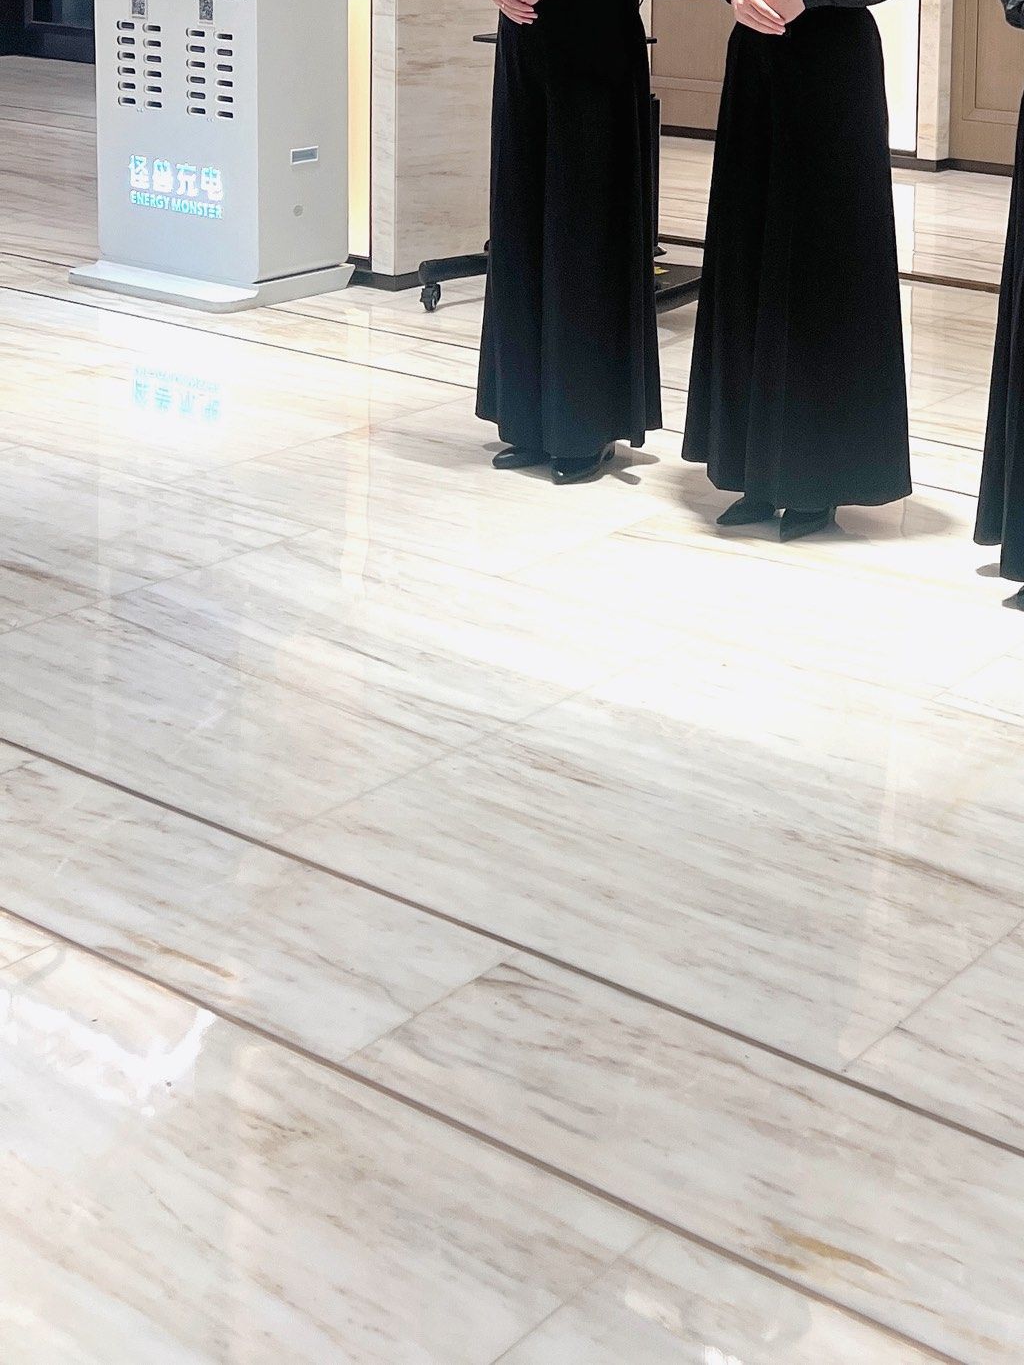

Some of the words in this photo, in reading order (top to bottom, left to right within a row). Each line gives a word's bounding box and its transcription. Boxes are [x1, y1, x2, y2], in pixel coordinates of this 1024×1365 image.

[128, 154, 224, 201] 怪兽充电
[130, 189, 170, 210] ENERGY
[171, 197, 224, 219] MONSTER
